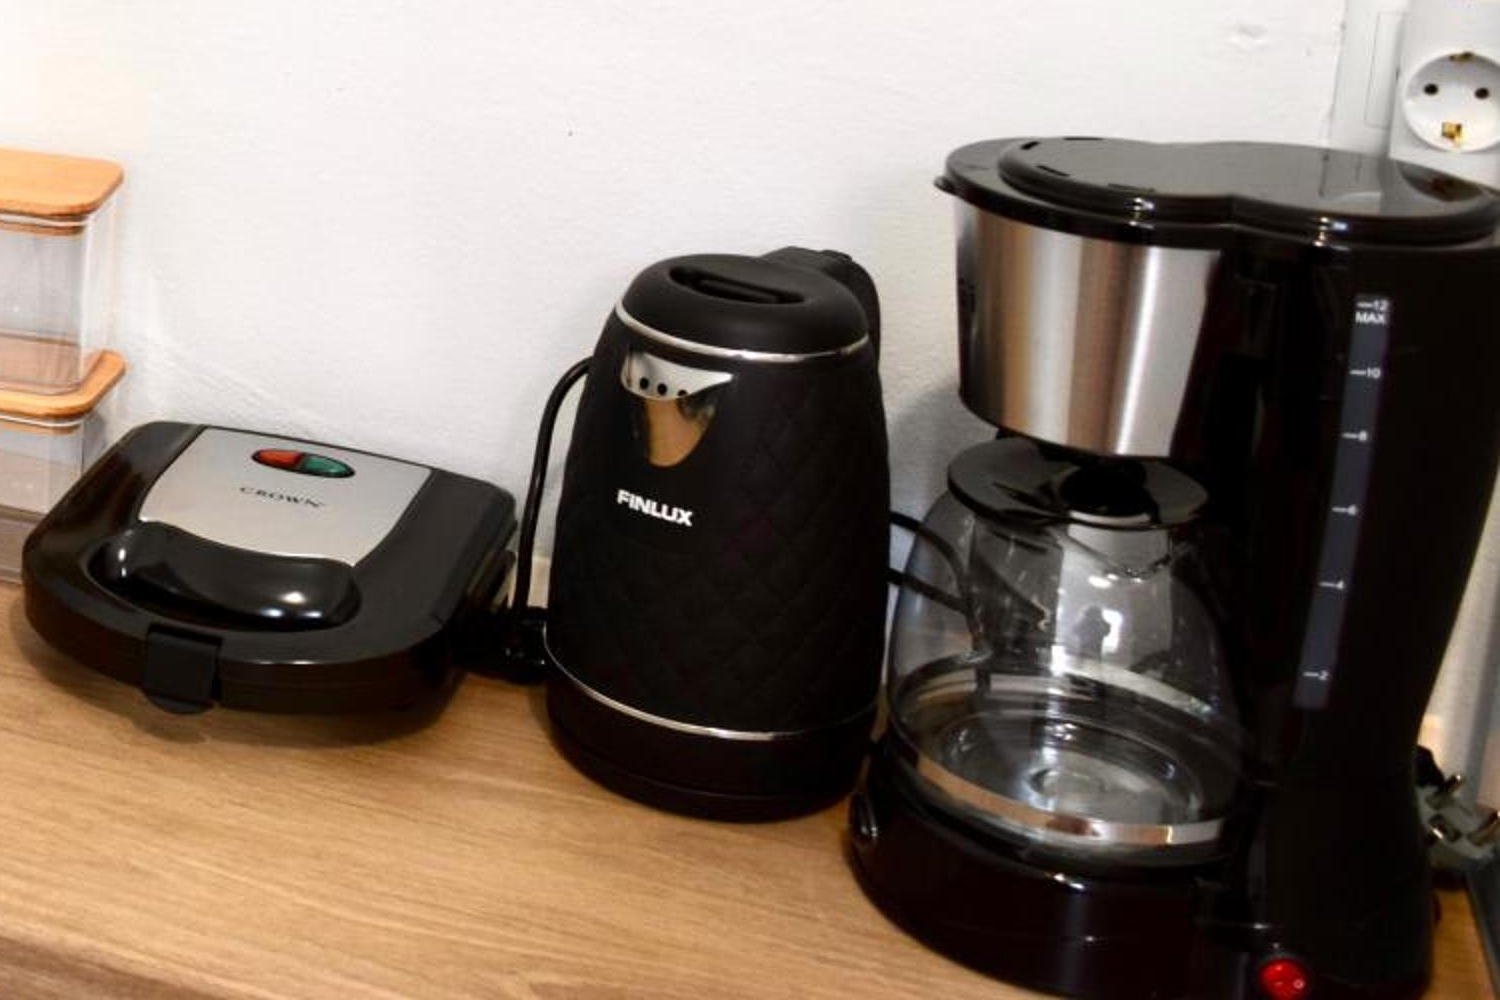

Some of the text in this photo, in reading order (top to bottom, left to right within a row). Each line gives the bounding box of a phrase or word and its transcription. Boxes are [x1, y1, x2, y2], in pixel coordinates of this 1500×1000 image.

[1373, 299, 1389, 311] 12
[1355, 311, 1386, 324] MAX
[1367, 367, 1381, 379] 10
[239, 486, 322, 508] CROWN
[617, 489, 693, 527] FINLUX
